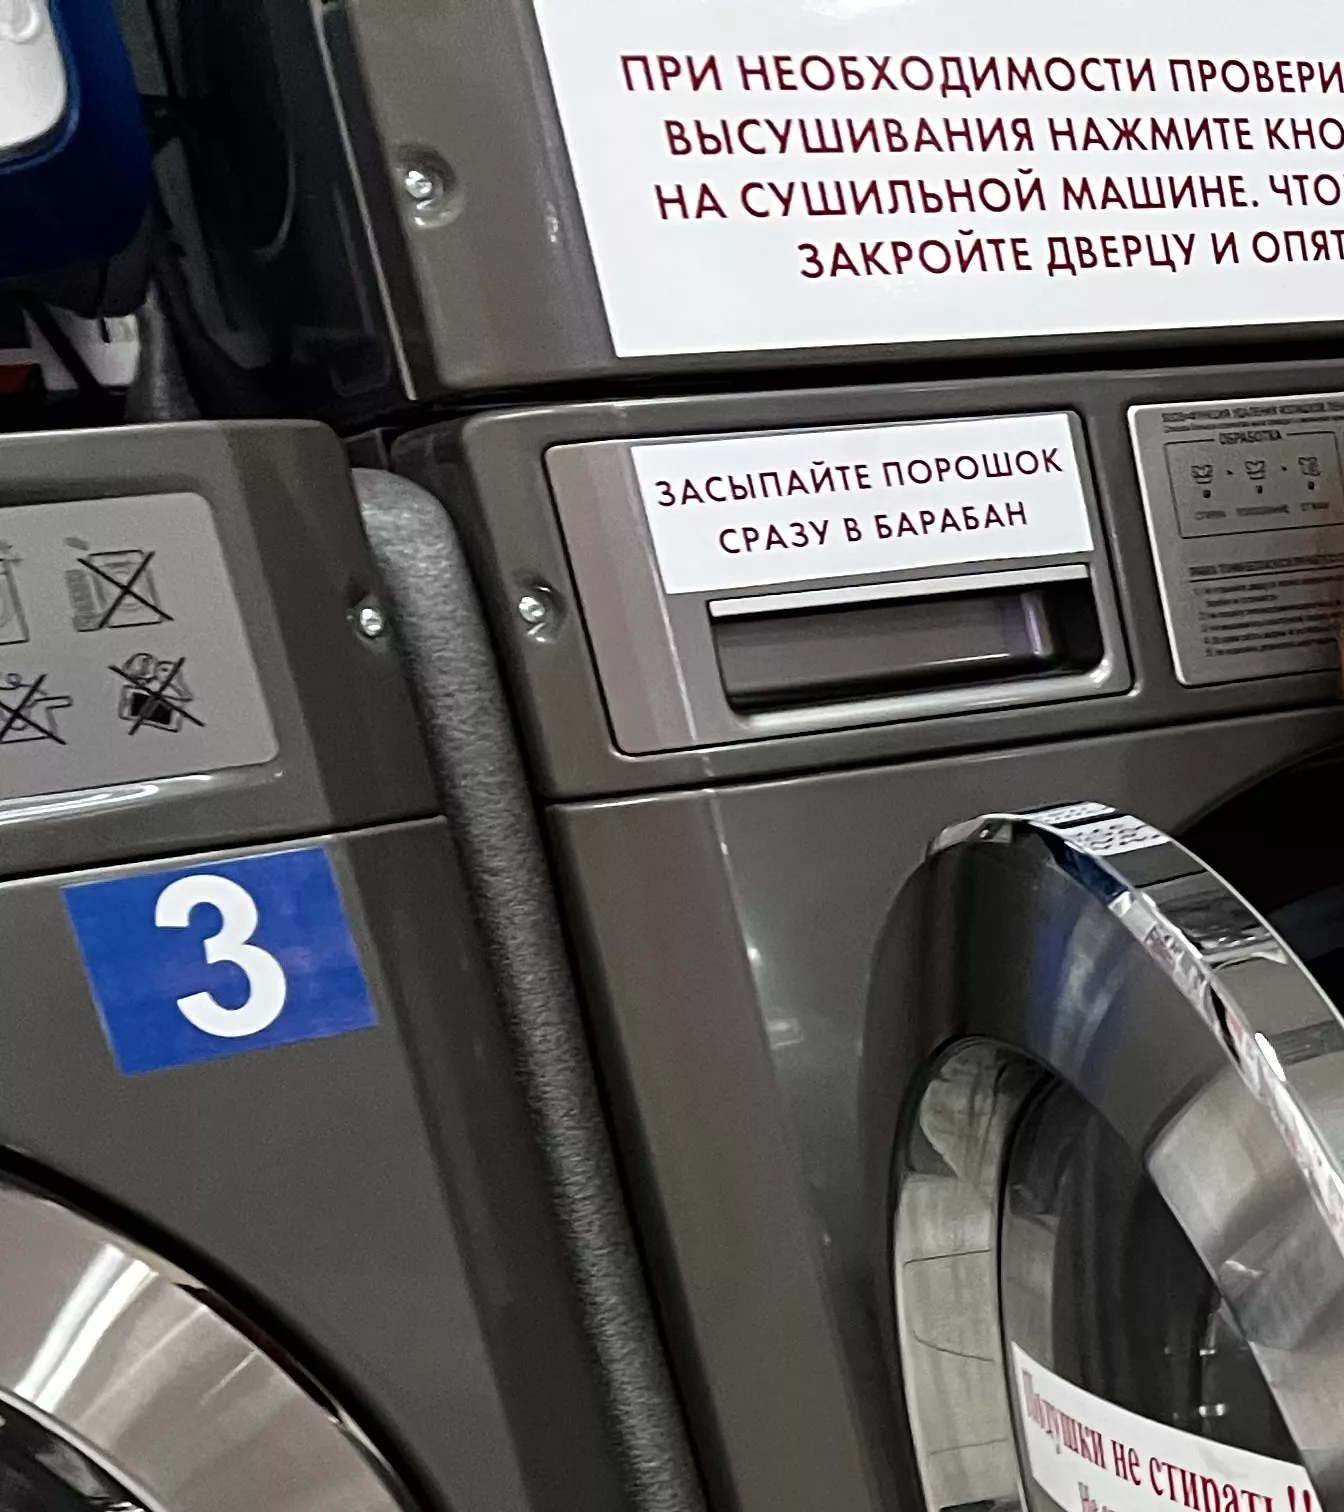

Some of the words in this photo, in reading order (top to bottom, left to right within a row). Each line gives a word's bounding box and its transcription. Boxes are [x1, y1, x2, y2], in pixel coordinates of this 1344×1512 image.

[620, 54, 723, 92] ПРИ
[737, 54, 1156, 99] НЕОБХОДИМОСТИ
[664, 117, 1035, 156] ВЫСУШИВАНИЯ
[1047, 116, 1254, 152] НАЖМИТЕ
[654, 182, 728, 220] НА
[740, 167, 1047, 218] СУШИЛЬНОЙ
[1062, 175, 1259, 211] МАШИНЕ.
[797, 228, 1033, 279] ЗАКРОЙТЕ
[1046, 233, 1196, 278] ДВЕРЦУ
[1210, 231, 1240, 265] И
[655, 460, 873, 507] ЗАСЫПАЙТЕ
[882, 447, 1063, 487] ПОРОШОК
[719, 519, 829, 554] СРАЗУ
[842, 517, 862, 542] В
[873, 501, 1027, 540] БАРАБАН
[155, 874, 287, 1038] 3
[1110, 1439, 1142, 1486] не
